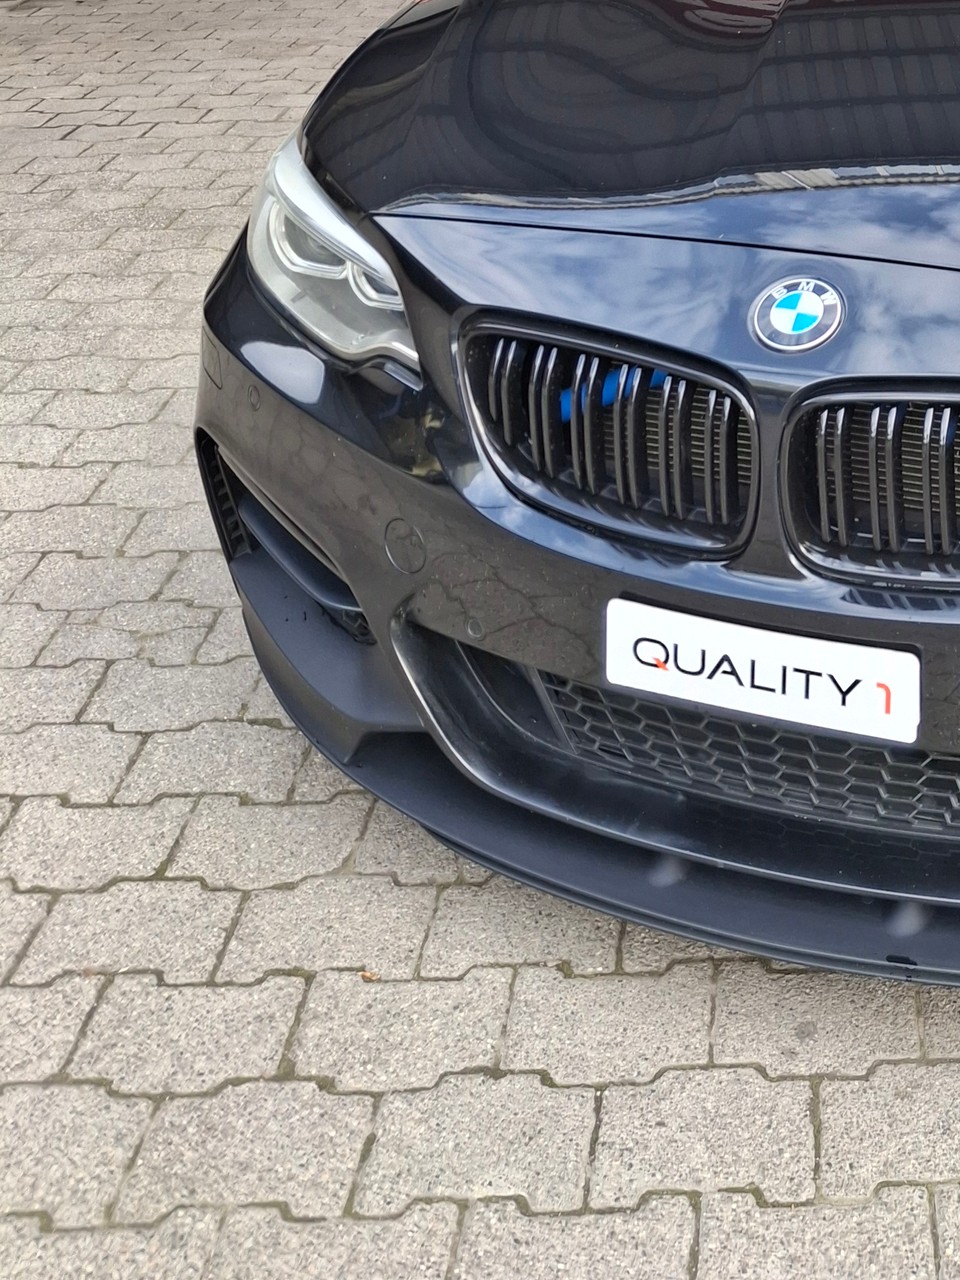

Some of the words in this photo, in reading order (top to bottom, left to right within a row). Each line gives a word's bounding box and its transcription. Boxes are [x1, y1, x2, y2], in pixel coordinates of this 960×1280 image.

[772, 281, 838, 306] BMW
[632, 637, 862, 707] QUALITY
[876, 682, 892, 715] 1
